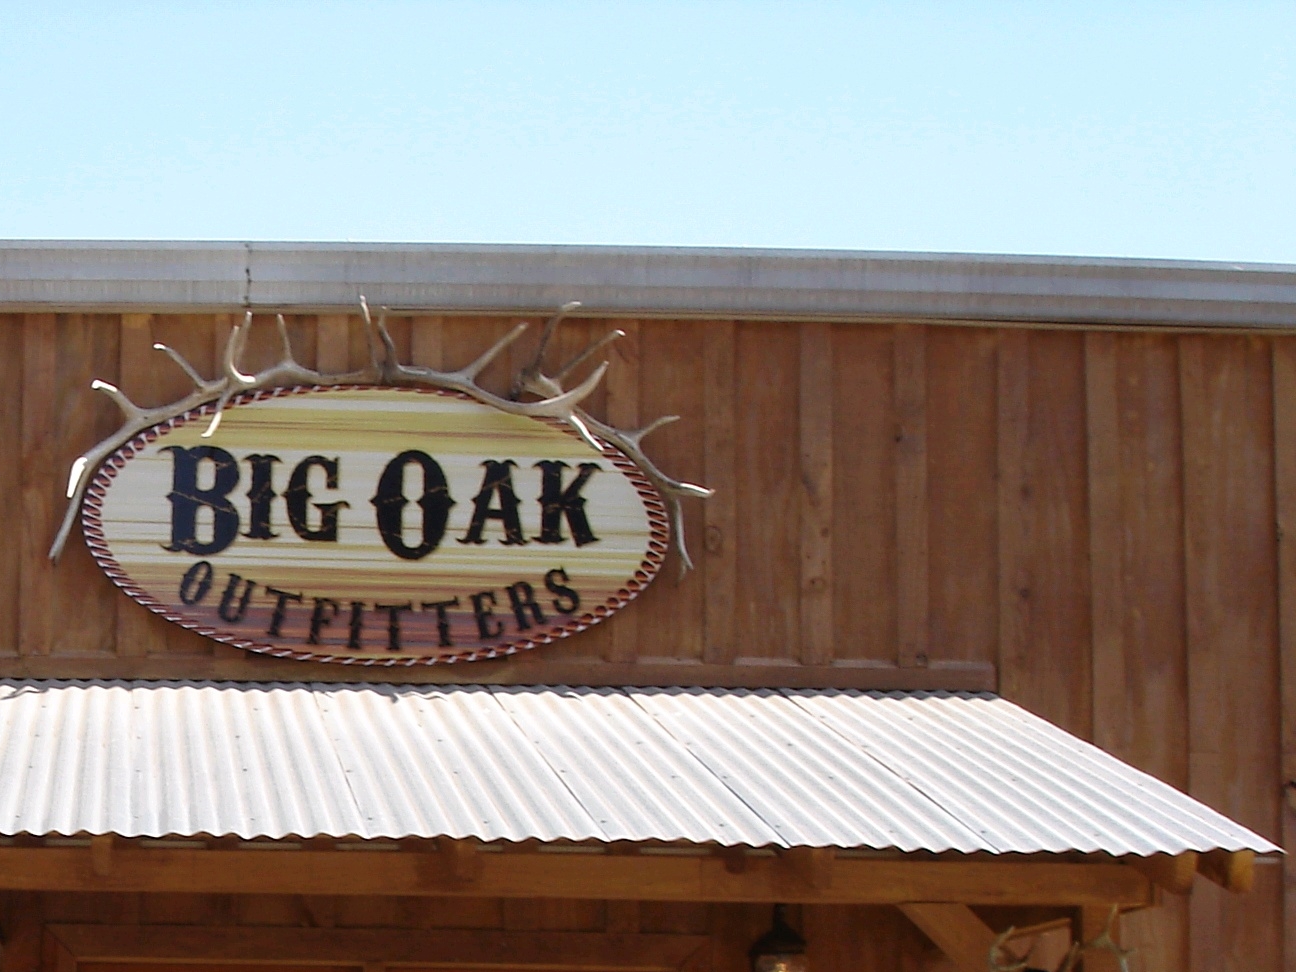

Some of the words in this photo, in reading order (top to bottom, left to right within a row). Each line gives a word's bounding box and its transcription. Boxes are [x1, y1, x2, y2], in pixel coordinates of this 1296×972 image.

[157, 444, 350, 556] BIG
[369, 449, 603, 561] OAK
[178, 559, 582, 653] OUTFITTERS
